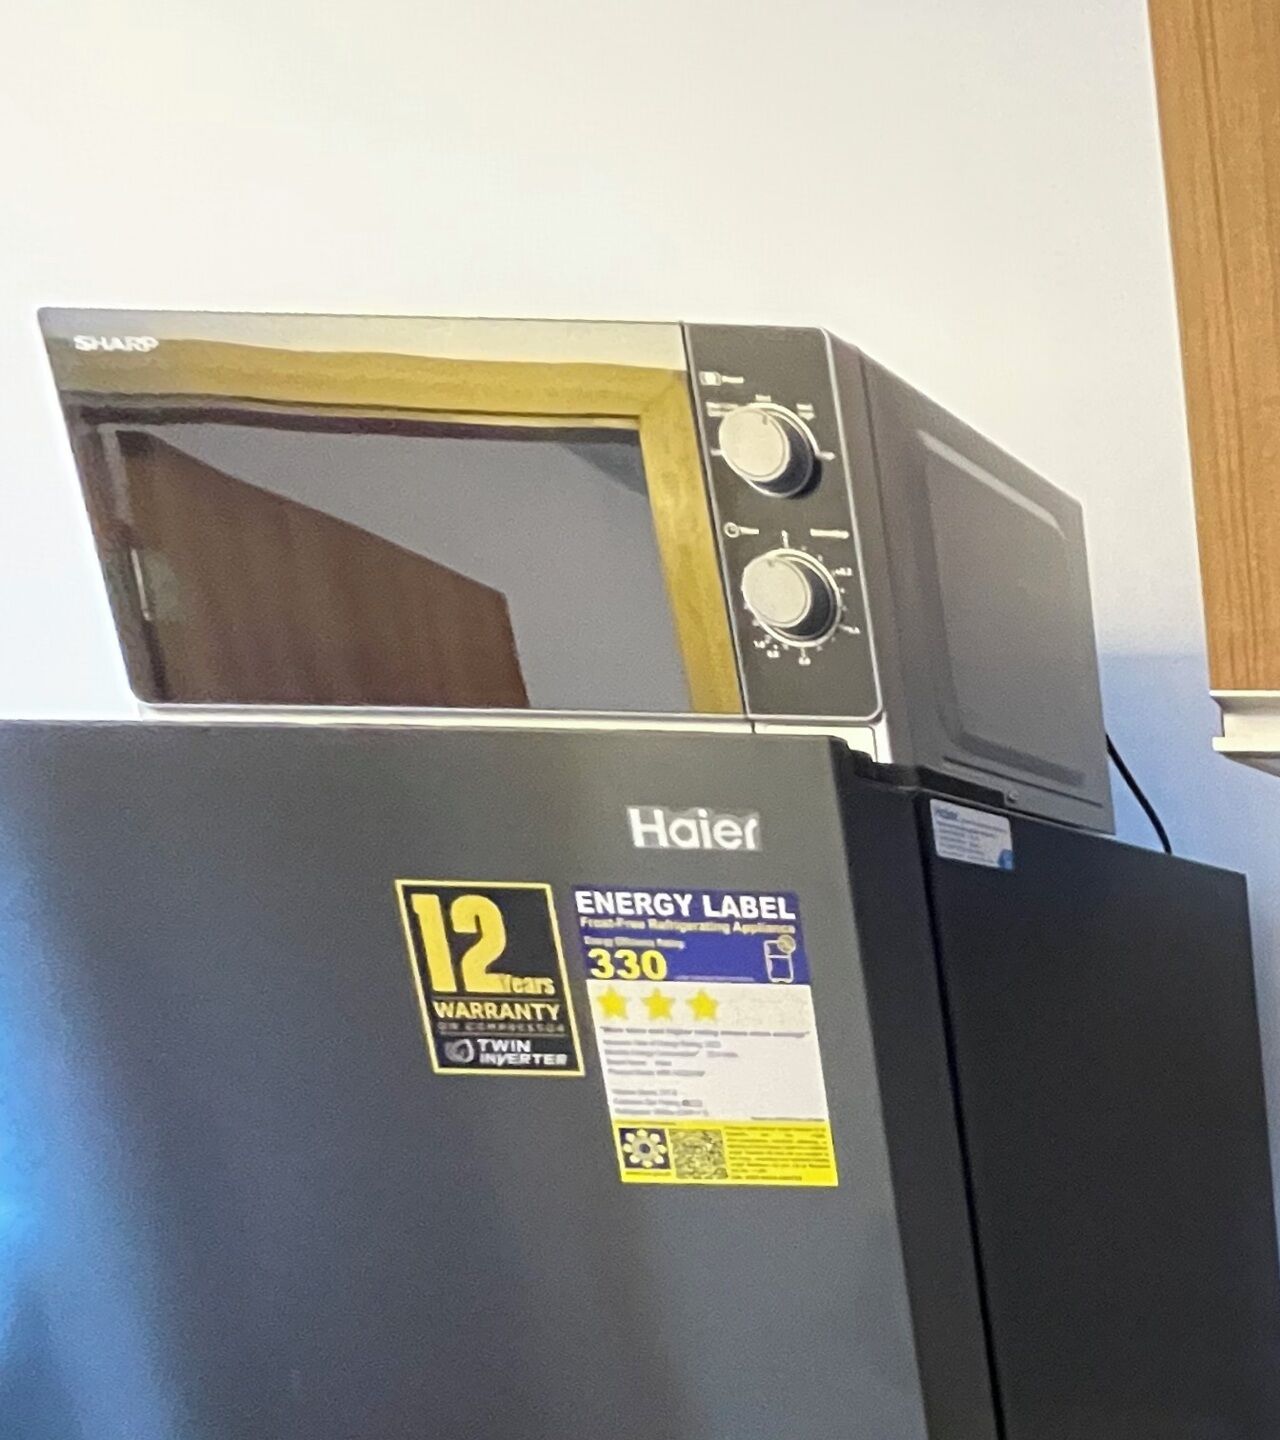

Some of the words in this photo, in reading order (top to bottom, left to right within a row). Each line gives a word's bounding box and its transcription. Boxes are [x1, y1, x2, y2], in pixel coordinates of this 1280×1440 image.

[73, 334, 160, 353] SHARP
[627, 807, 758, 850] Haier
[575, 890, 693, 917] ENERGY
[702, 895, 797, 920] LABEL
[411, 894, 508, 993] 12
[587, 948, 668, 981] 330
[432, 1001, 561, 1022] WARRANTY
[476, 1038, 532, 1053] TWIN
[479, 1053, 569, 1067] INVERTER
